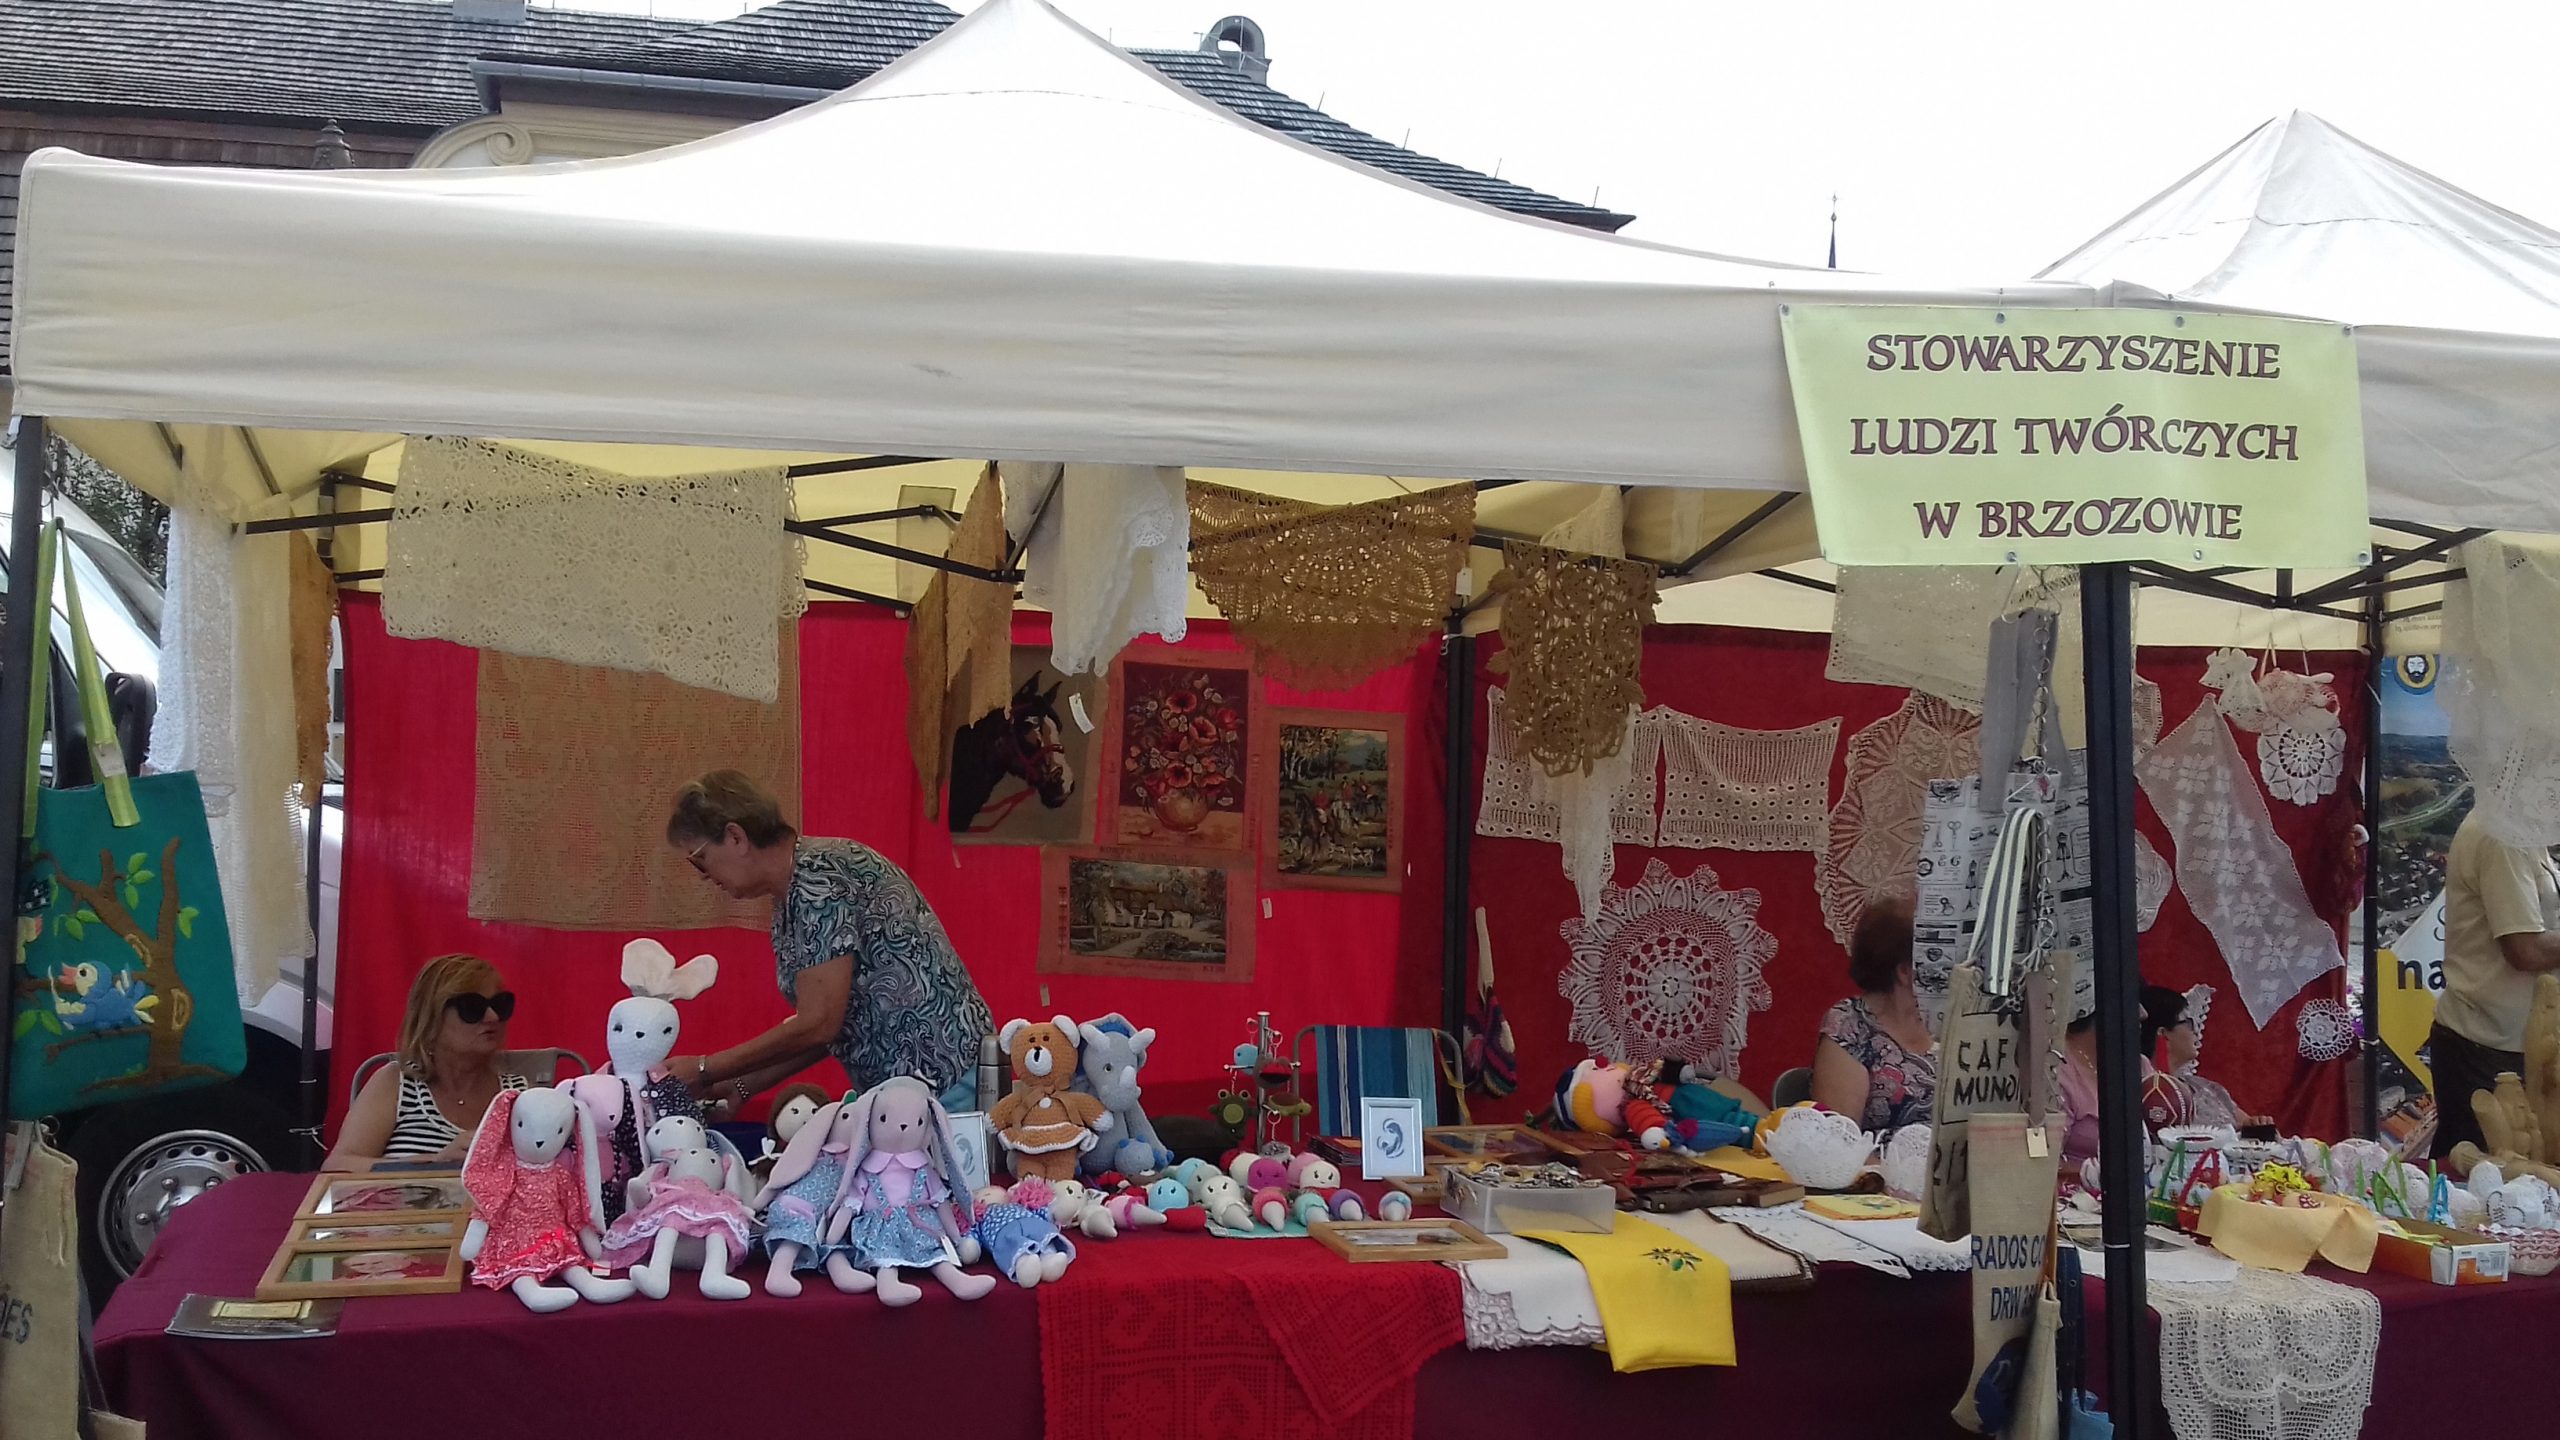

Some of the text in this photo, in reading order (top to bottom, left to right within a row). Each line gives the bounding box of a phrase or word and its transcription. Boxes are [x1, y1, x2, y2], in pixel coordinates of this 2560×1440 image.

[1867, 334, 2280, 379] STOWARZYSZENIE
[1850, 403, 2299, 461] LUDZI TWÓRCZYCH
[1913, 497, 2243, 540] W BRZOZOWIE
